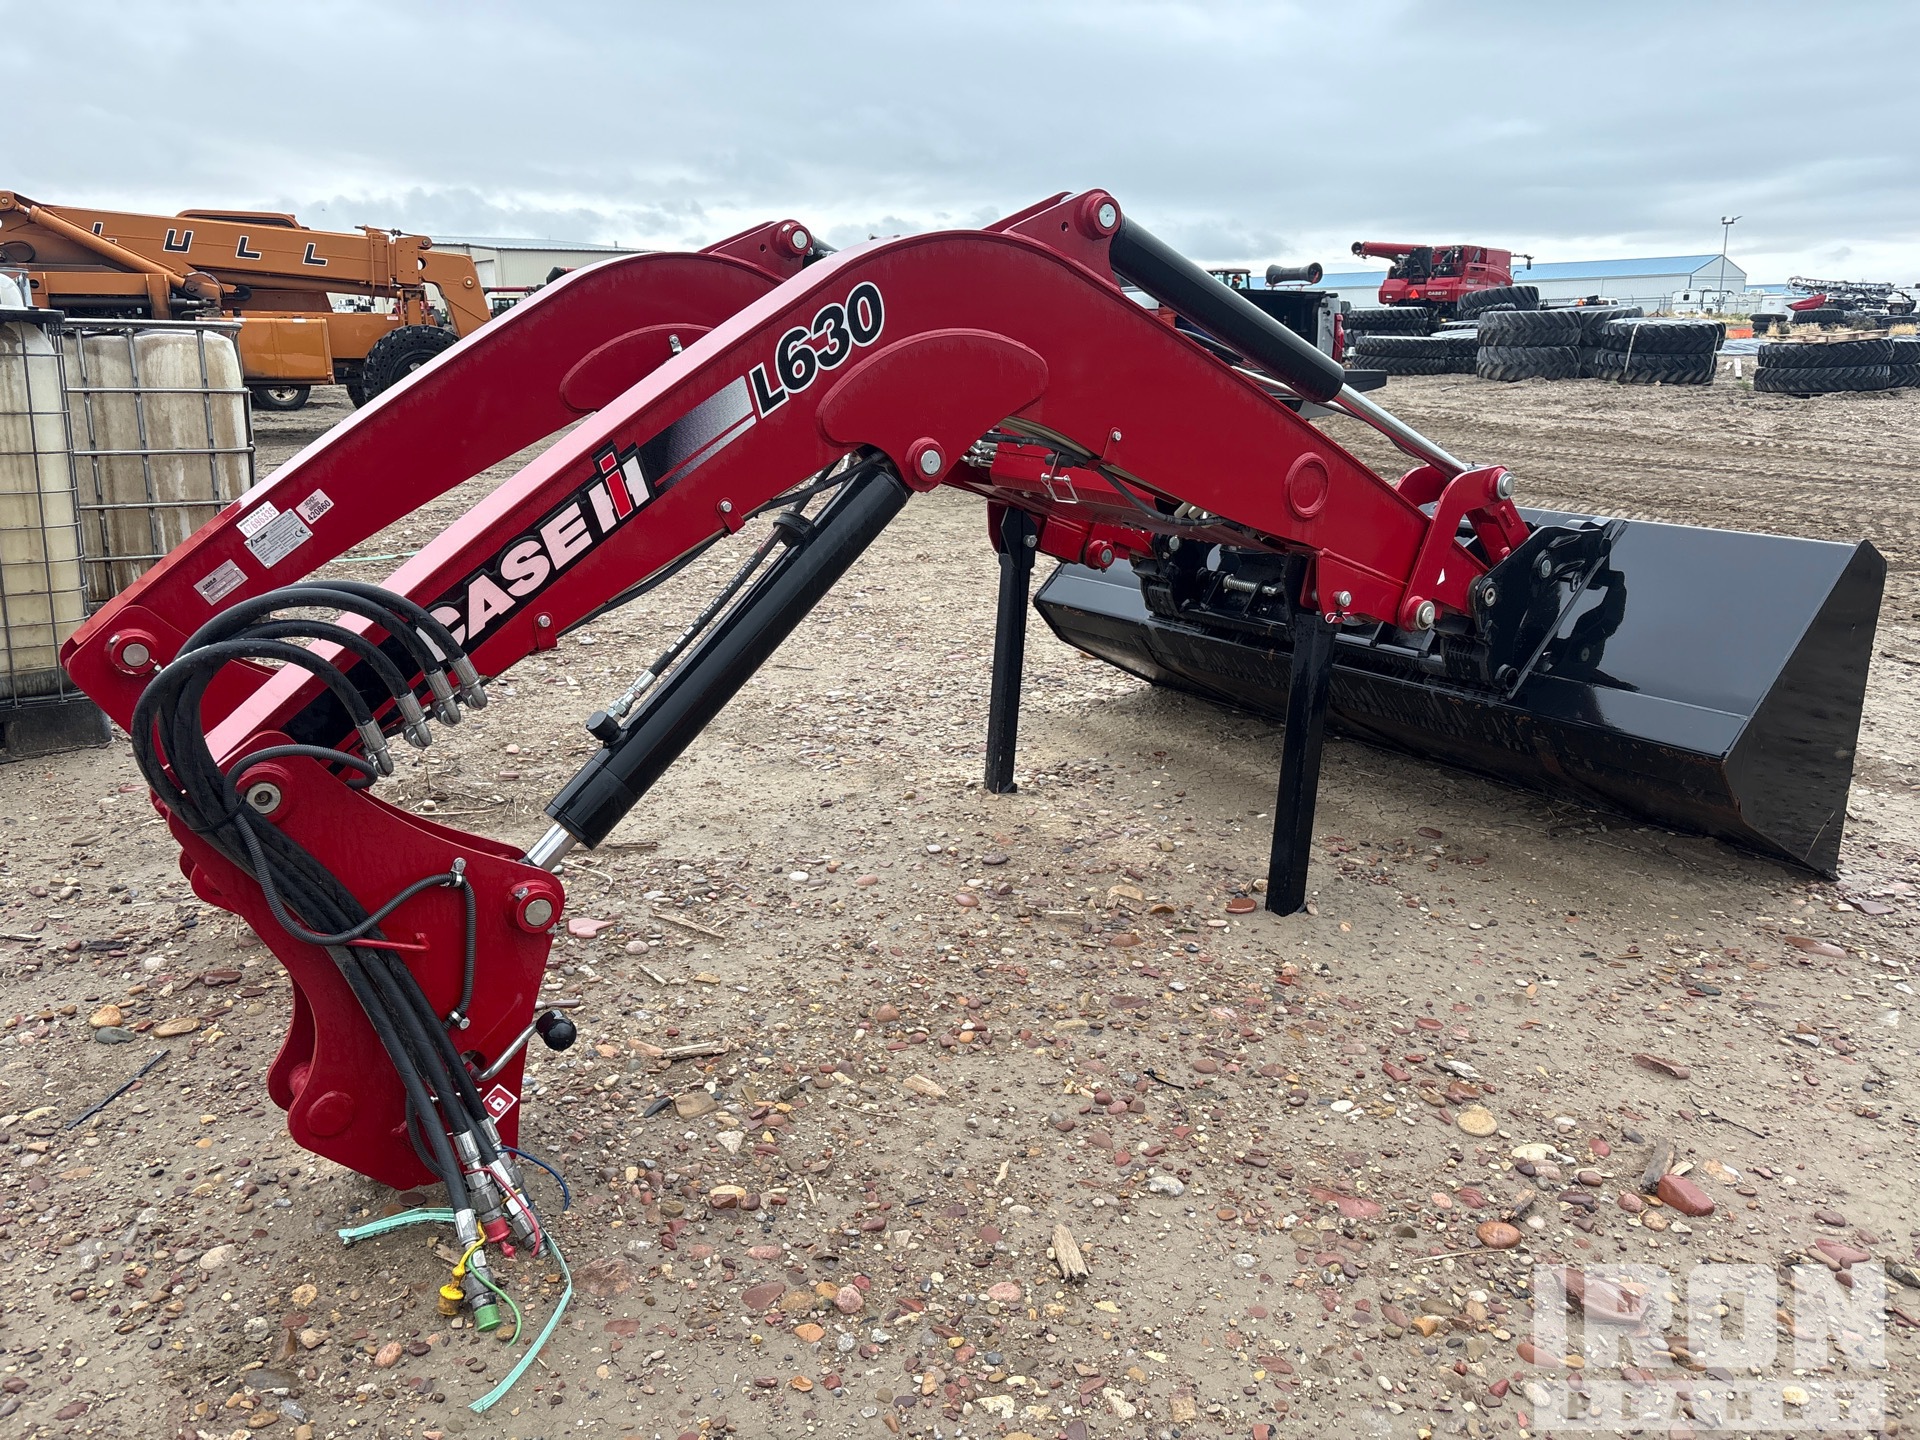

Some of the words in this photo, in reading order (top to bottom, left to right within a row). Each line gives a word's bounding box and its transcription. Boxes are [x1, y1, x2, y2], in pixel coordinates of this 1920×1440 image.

[748, 281, 885, 419] L630
[243, 506, 277, 534] 47696335
[308, 500, 331, 521] 420860
